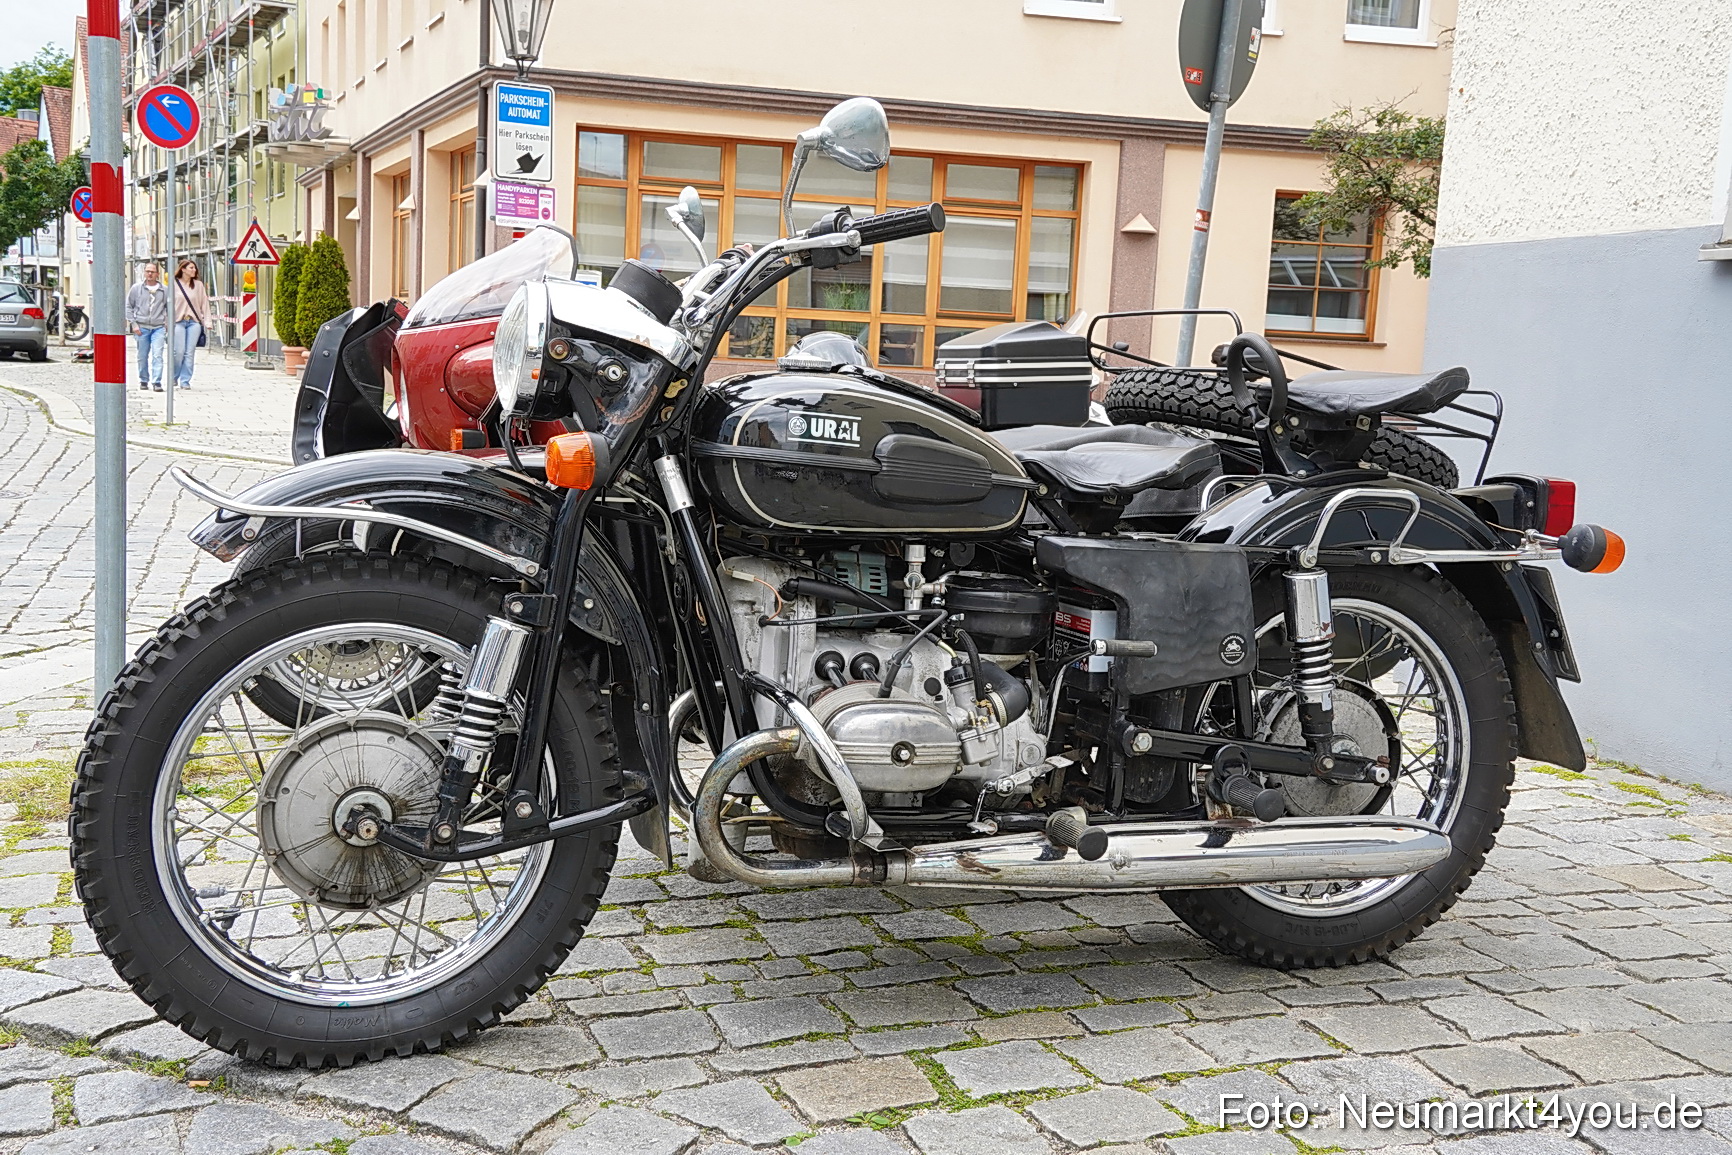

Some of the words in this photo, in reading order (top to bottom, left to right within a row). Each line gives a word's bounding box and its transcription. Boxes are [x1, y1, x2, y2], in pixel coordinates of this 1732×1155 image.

[500, 92, 549, 108] PARKSCHEIN-
[507, 106, 542, 120] AUTOMAT
[498, 128, 512, 138] Hier
[515, 129, 550, 142] Parkschein
[515, 141, 533, 152] lösen
[497, 183, 538, 196] HANDYPARKEN
[810, 417, 861, 442] URAL
[1055, 611, 1072, 624] BS
